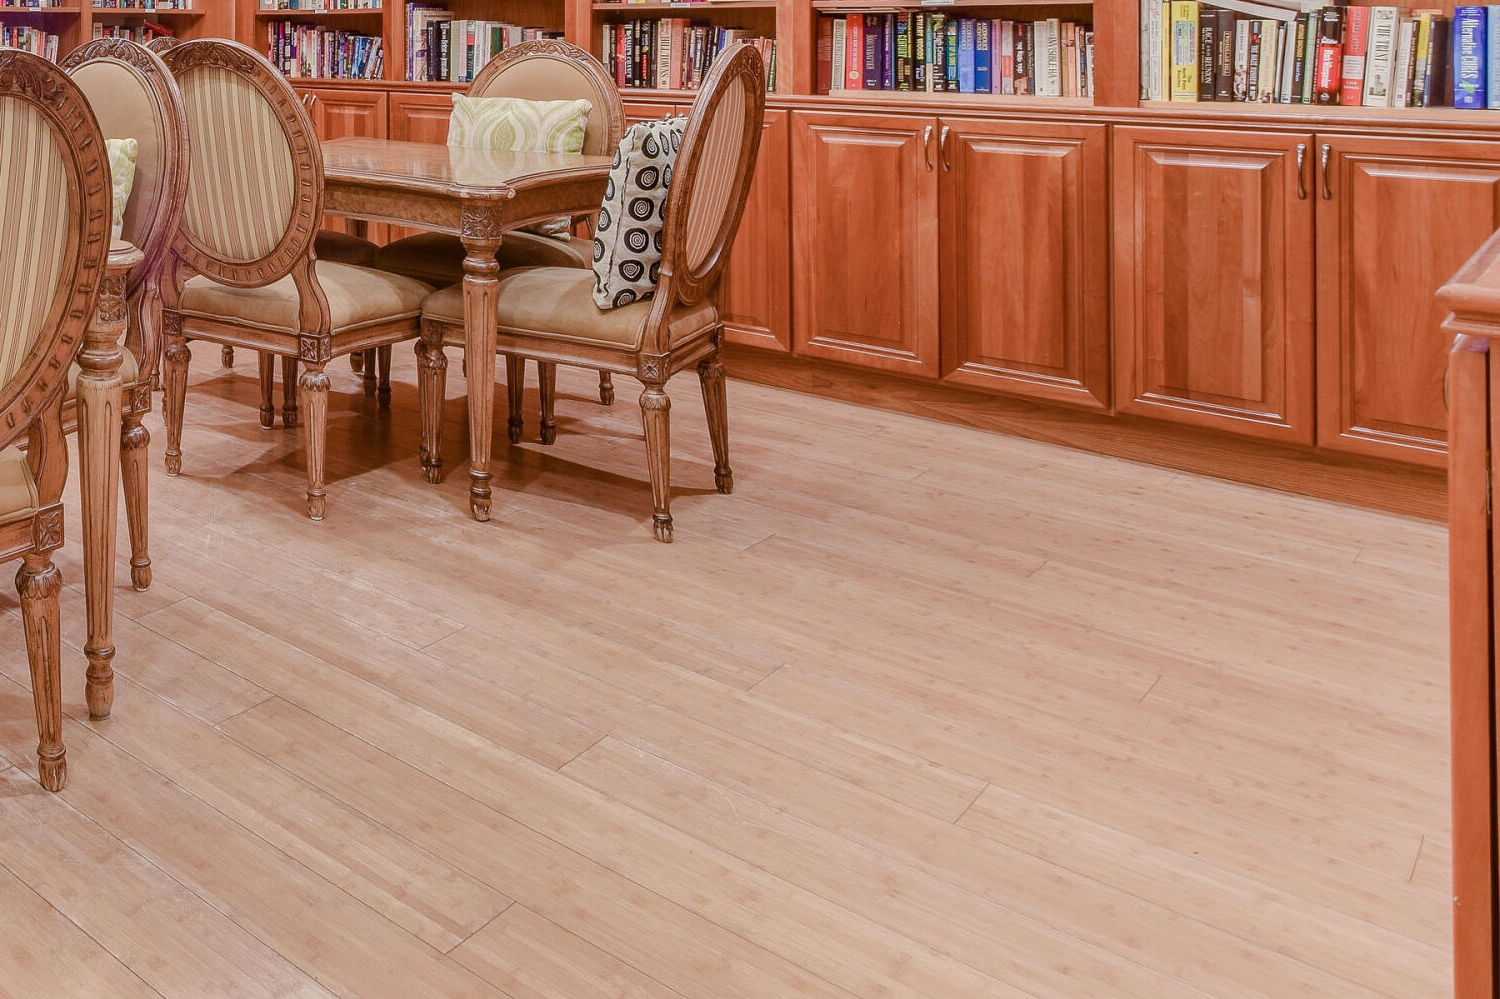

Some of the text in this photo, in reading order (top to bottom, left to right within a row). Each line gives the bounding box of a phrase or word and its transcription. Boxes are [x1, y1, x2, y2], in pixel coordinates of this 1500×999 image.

[898, 35, 907, 57] CENTURY
[1204, 27, 1212, 43] RACE
[1374, 25, 1391, 62] THE TRUST
[660, 37, 670, 78] HILL TOWNS
[1047, 37, 1057, 66] INVISIBLE
[1250, 45, 1258, 53] THE
[1250, 55, 1258, 65] MAZE
[1461, 19, 1479, 78] Alternative CURES
